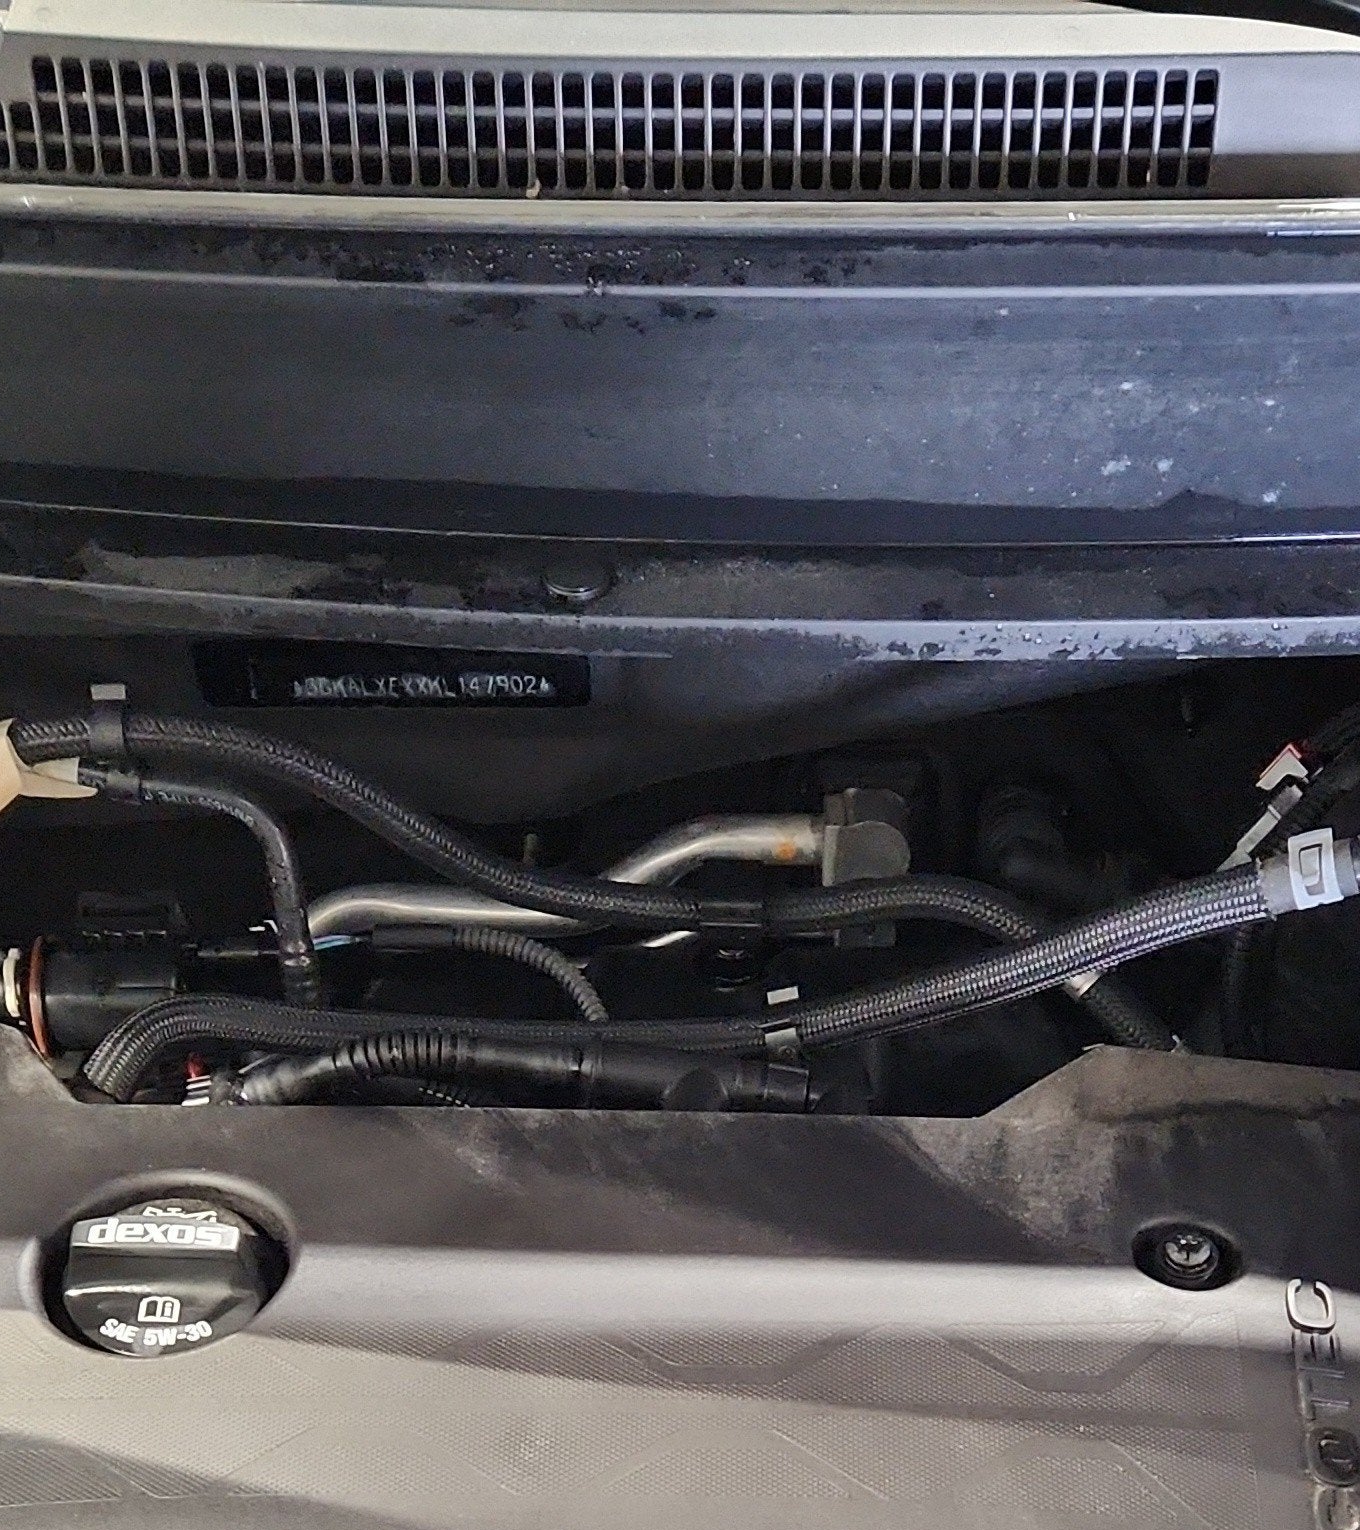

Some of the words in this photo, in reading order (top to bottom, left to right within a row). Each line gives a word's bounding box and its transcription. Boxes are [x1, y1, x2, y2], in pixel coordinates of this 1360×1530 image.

[87, 1217, 224, 1247] dexos
[99, 1318, 139, 1344] SAE
[143, 1320, 213, 1346] 5W-30
